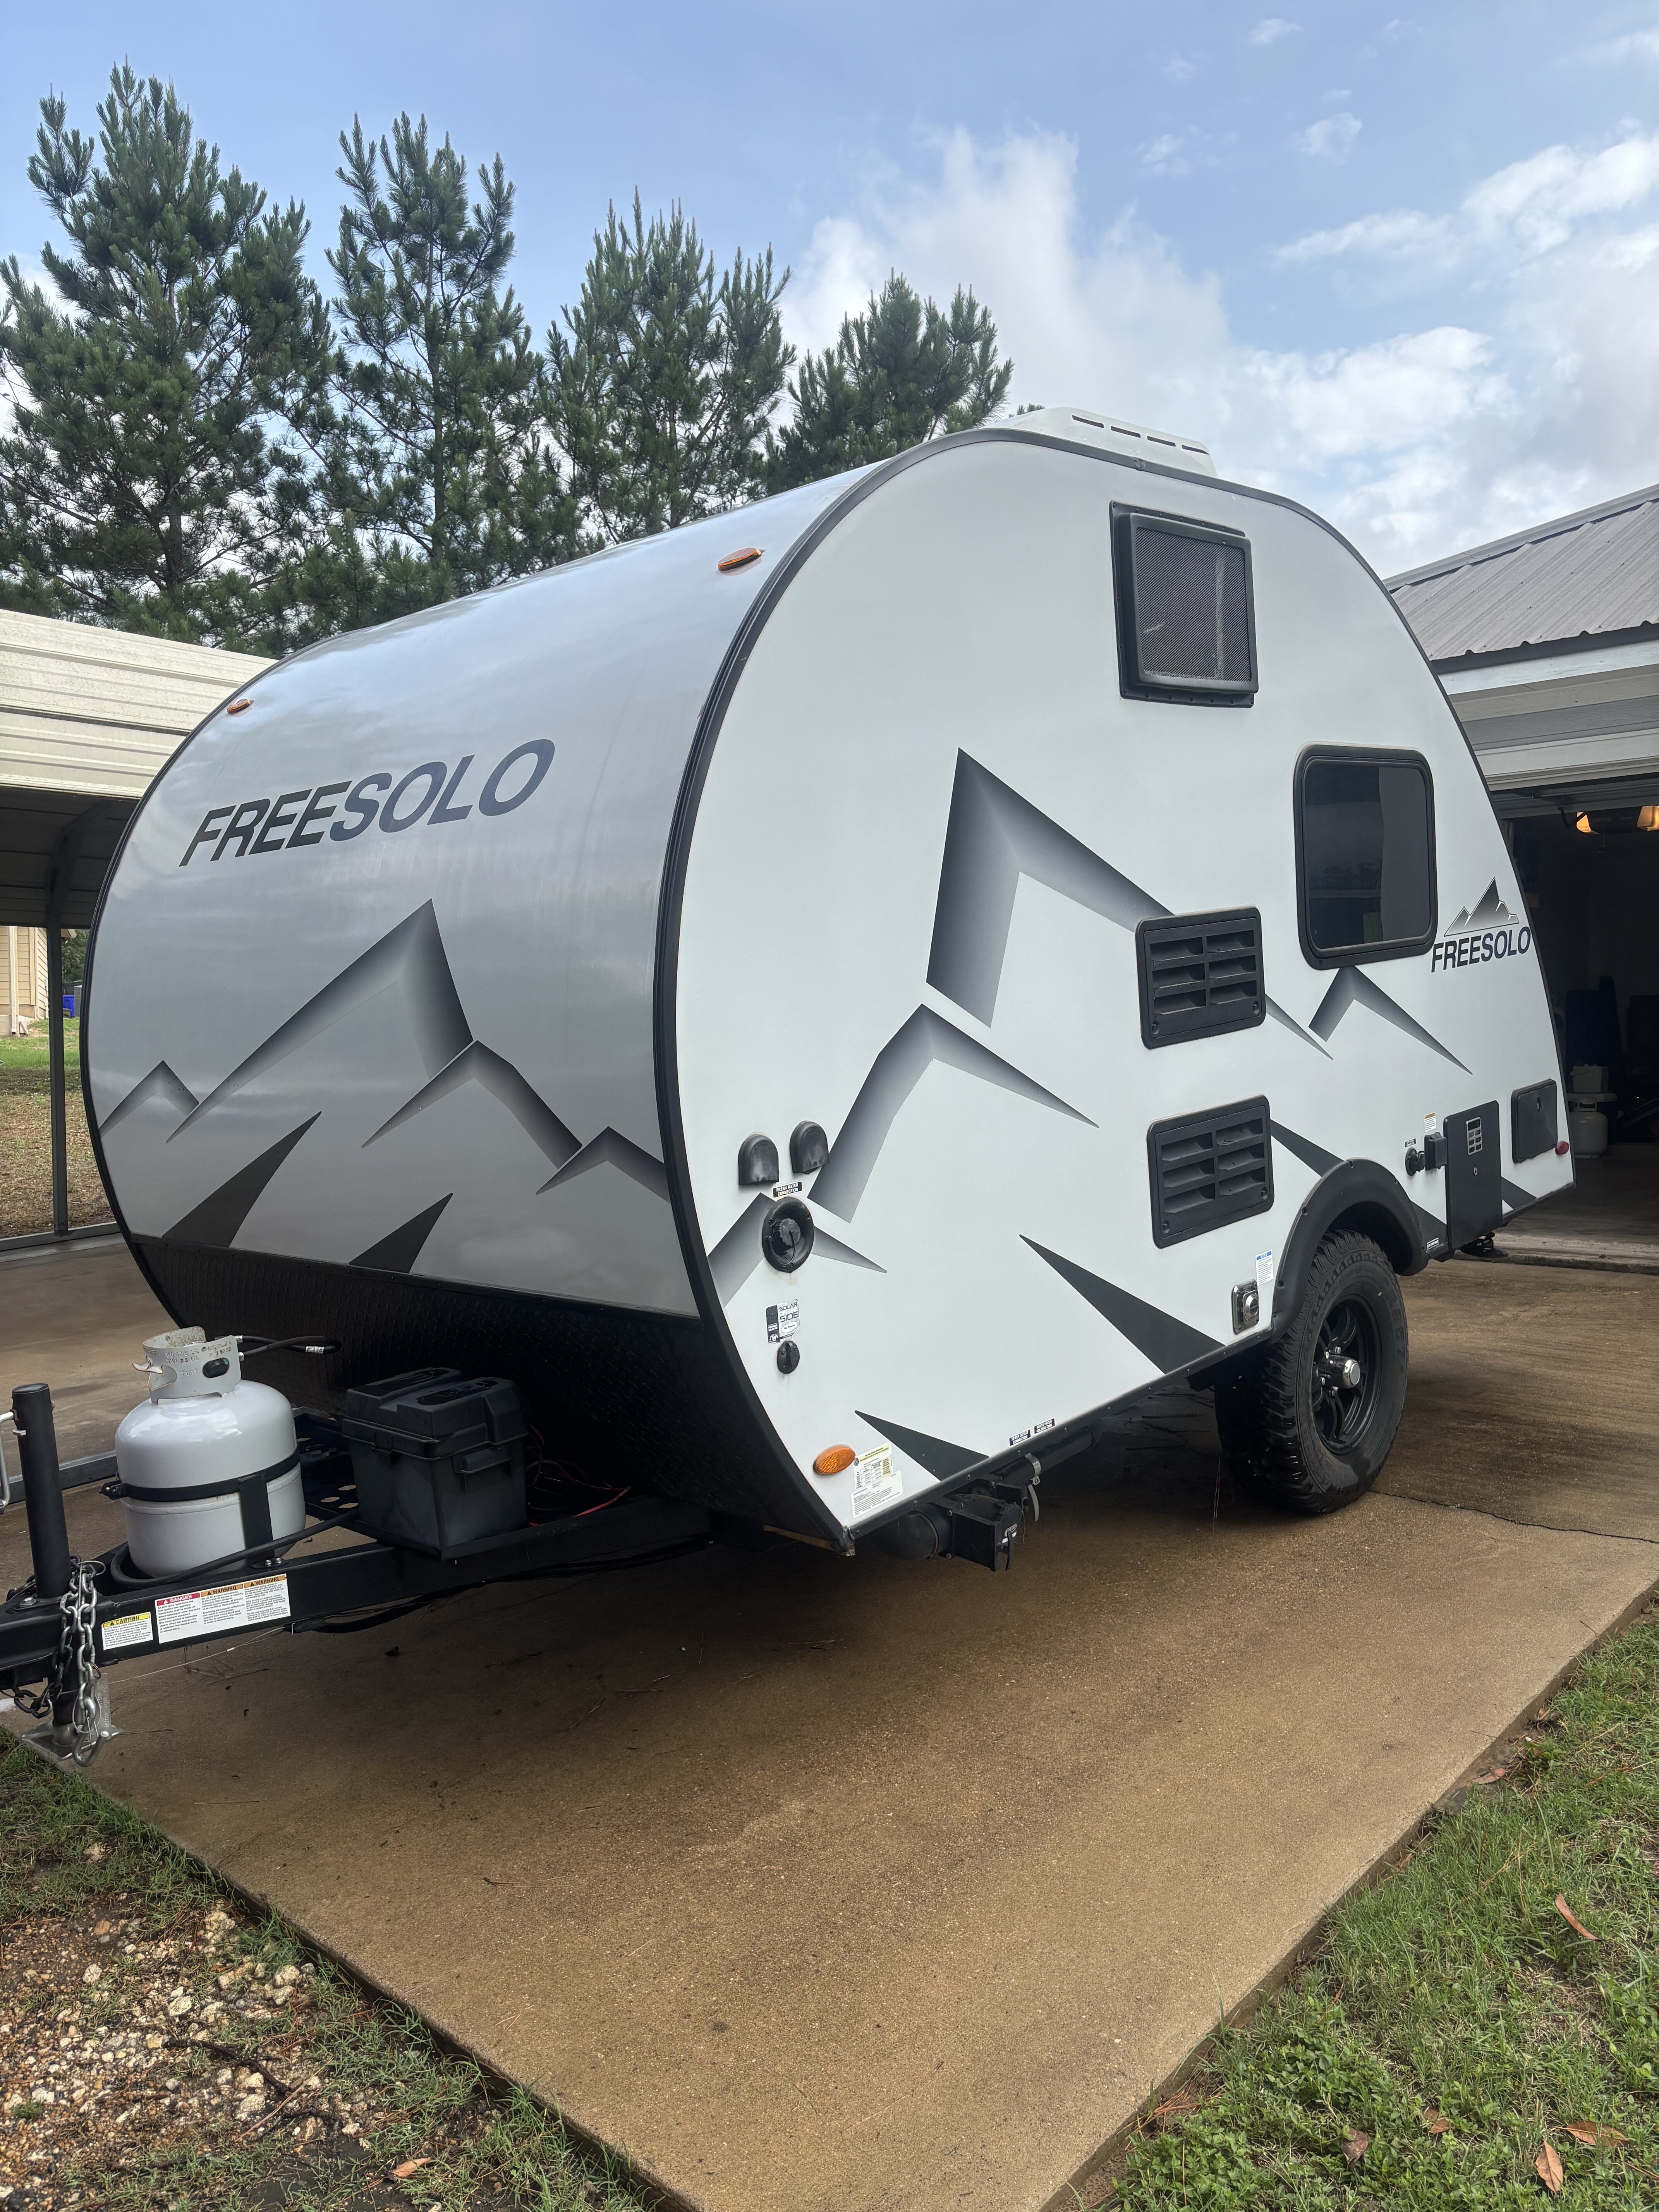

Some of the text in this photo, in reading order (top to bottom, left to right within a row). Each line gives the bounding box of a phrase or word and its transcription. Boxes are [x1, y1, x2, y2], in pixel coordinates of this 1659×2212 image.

[179, 739, 555, 867] FREESOLO
[1431, 926, 1531, 973] FREESOLO
[777, 1187, 798, 1196] CONNECTION
[779, 1302, 798, 1312] SOLAR
[780, 1311, 799, 1323] SIDE
[255, 1577, 279, 1586] WARNING
[212, 1585, 237, 1594] WARNING
[170, 1594, 192, 1603] DANGER
[116, 1615, 139, 1625] CAUTION
